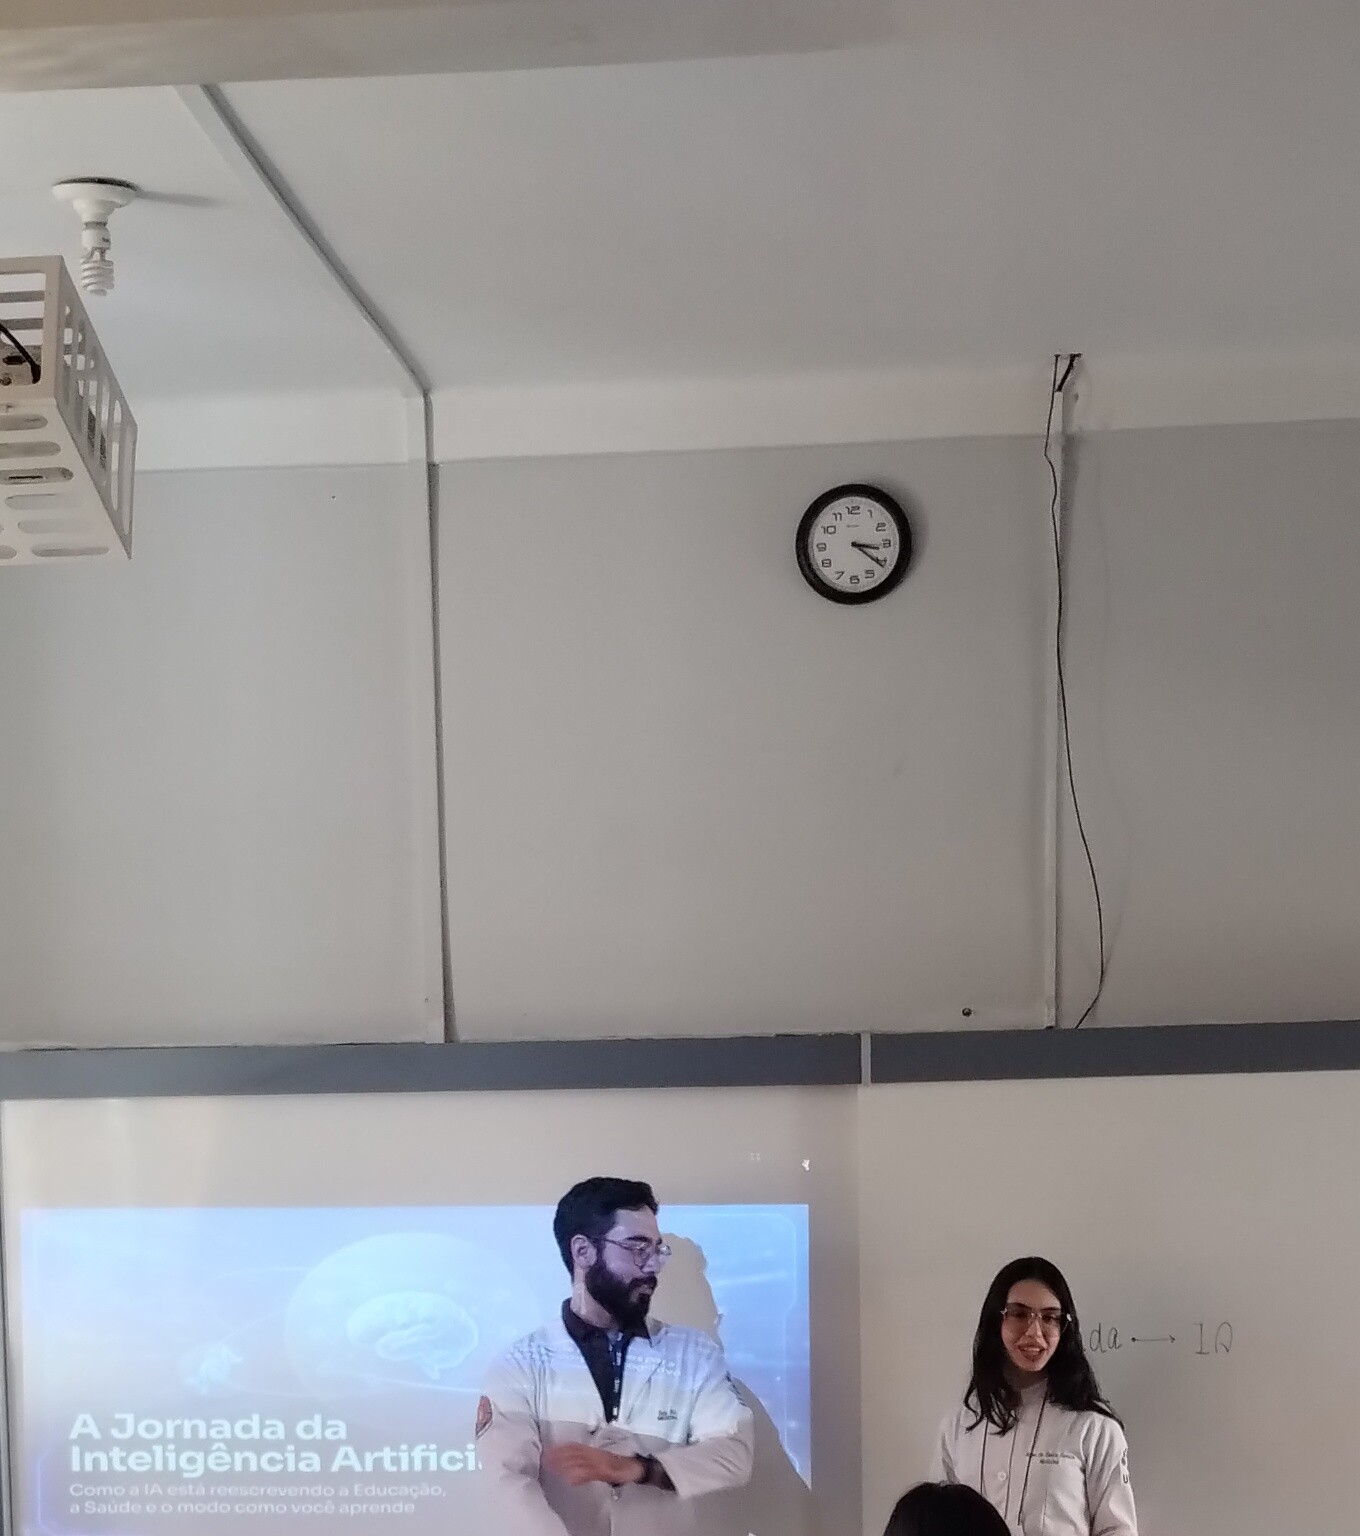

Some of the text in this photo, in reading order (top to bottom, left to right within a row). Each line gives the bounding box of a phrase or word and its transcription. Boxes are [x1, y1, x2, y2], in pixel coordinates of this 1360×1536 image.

[845, 505, 861, 515] 12
[833, 512, 843, 521] 11
[821, 525, 837, 535] 10
[876, 522, 887, 532] 2
[816, 542, 827, 552] 9
[882, 538, 891, 548] 3
[821, 558, 832, 568] 8
[835, 571, 845, 580] 7
[865, 569, 875, 579] 5
[849, 575, 860, 584] 6
[1083, 1323, 1122, 1353] da
[68, 1413, 347, 1440] A Jornada da
[71, 1442, 483, 1478] Inteligência Artifici
[69, 1482, 447, 1499] Como a IA está reescrevendo a Educação,
[69, 1500, 416, 1516] a Saúde e o modo como você aprende
